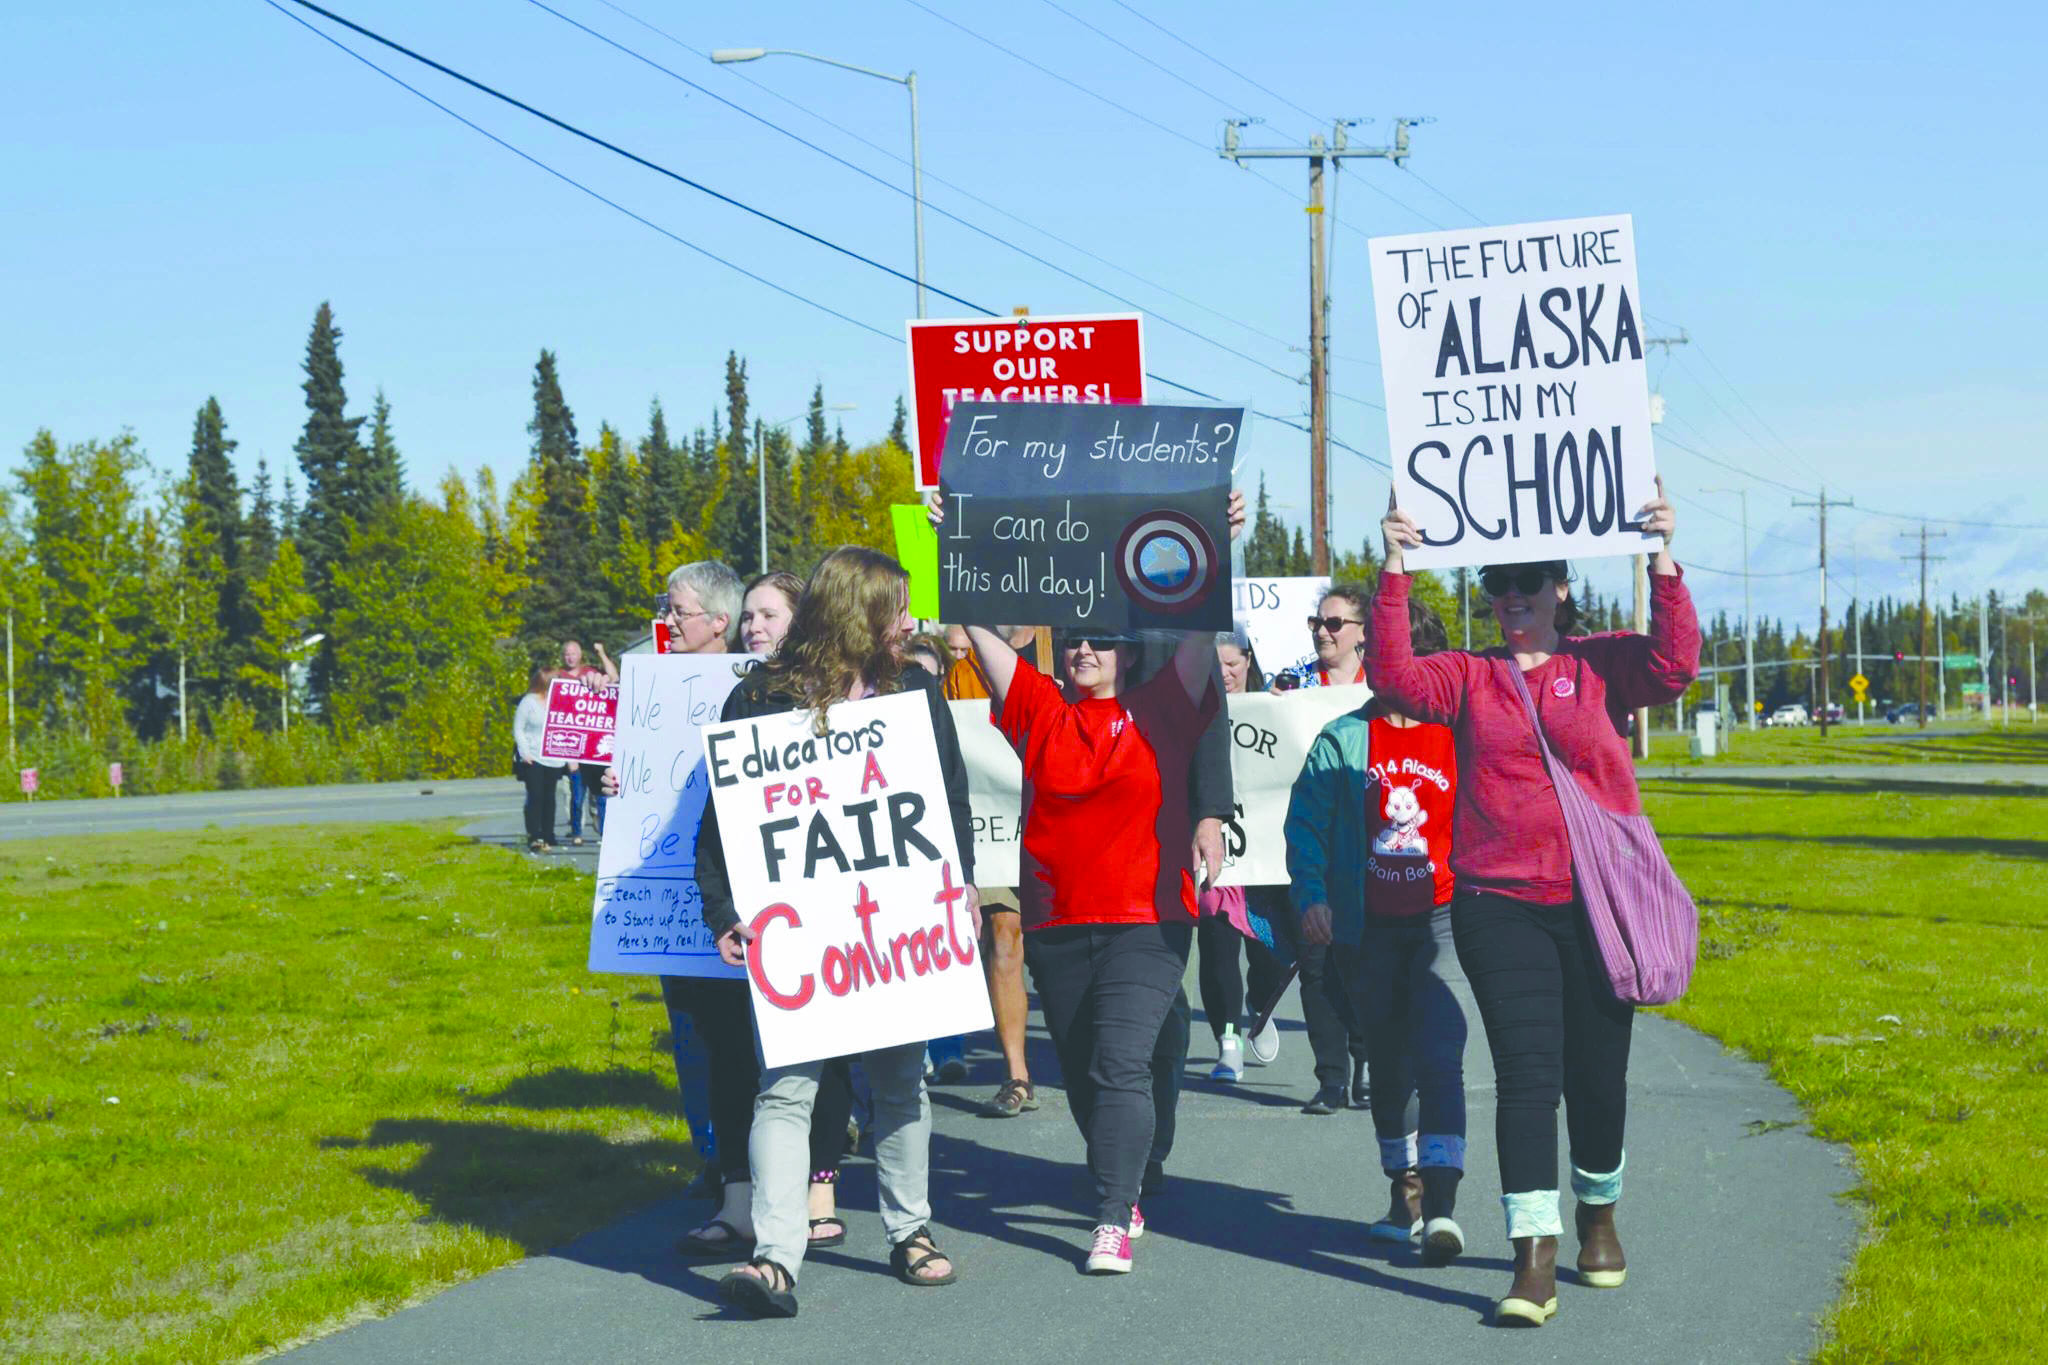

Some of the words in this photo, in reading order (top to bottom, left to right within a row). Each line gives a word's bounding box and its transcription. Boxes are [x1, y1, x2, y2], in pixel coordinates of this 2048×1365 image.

[1387, 245, 1474, 284] THE
[1479, 229, 1622, 279] FUTURE
[953, 327, 1096, 354] SUPPORT
[1398, 289, 1438, 329] OF
[1435, 283, 1643, 378] ALASKA
[992, 357, 1059, 381] OUR
[942, 383, 1112, 408] TEACHERS!
[1422, 390, 1475, 428] IS
[1477, 384, 1521, 423] IN
[1536, 381, 1577, 419] MY
[962, 415, 1009, 457] For
[1022, 437, 1066, 479] my
[1089, 420, 1235, 464] students?
[1407, 426, 1648, 548] SCHOOL
[948, 494, 974, 539] I
[993, 515, 1046, 542] can
[1056, 500, 1090, 542] do
[944, 552, 991, 593] this
[1001, 557, 1029, 594] all
[1039, 552, 1106, 618] day!
[1234, 583, 1280, 610] IDS
[560, 683, 619, 700] SUPOR
[575, 699, 608, 714] OUR
[631, 665, 663, 731] We
[681, 674, 721, 727] Tea
[549, 711, 617, 730] TEACHER
[1228, 719, 1277, 759] OR
[620, 749, 653, 799] We
[763, 777, 830, 813] FOR
[860, 750, 889, 794] A
[1402, 758, 1450, 792] Alaska
[639, 813, 681, 860] Be
[759, 791, 943, 883] FAIR
[1367, 857, 1400, 883] Brain
[1405, 861, 1435, 882] Bee
[615, 886, 652, 902] teach
[604, 912, 617, 926] to
[659, 914, 674, 930] up
[678, 909, 699, 928] for
[617, 931, 649, 949] Here's
[676, 931, 697, 947] real
[746, 859, 975, 1011] Contract
